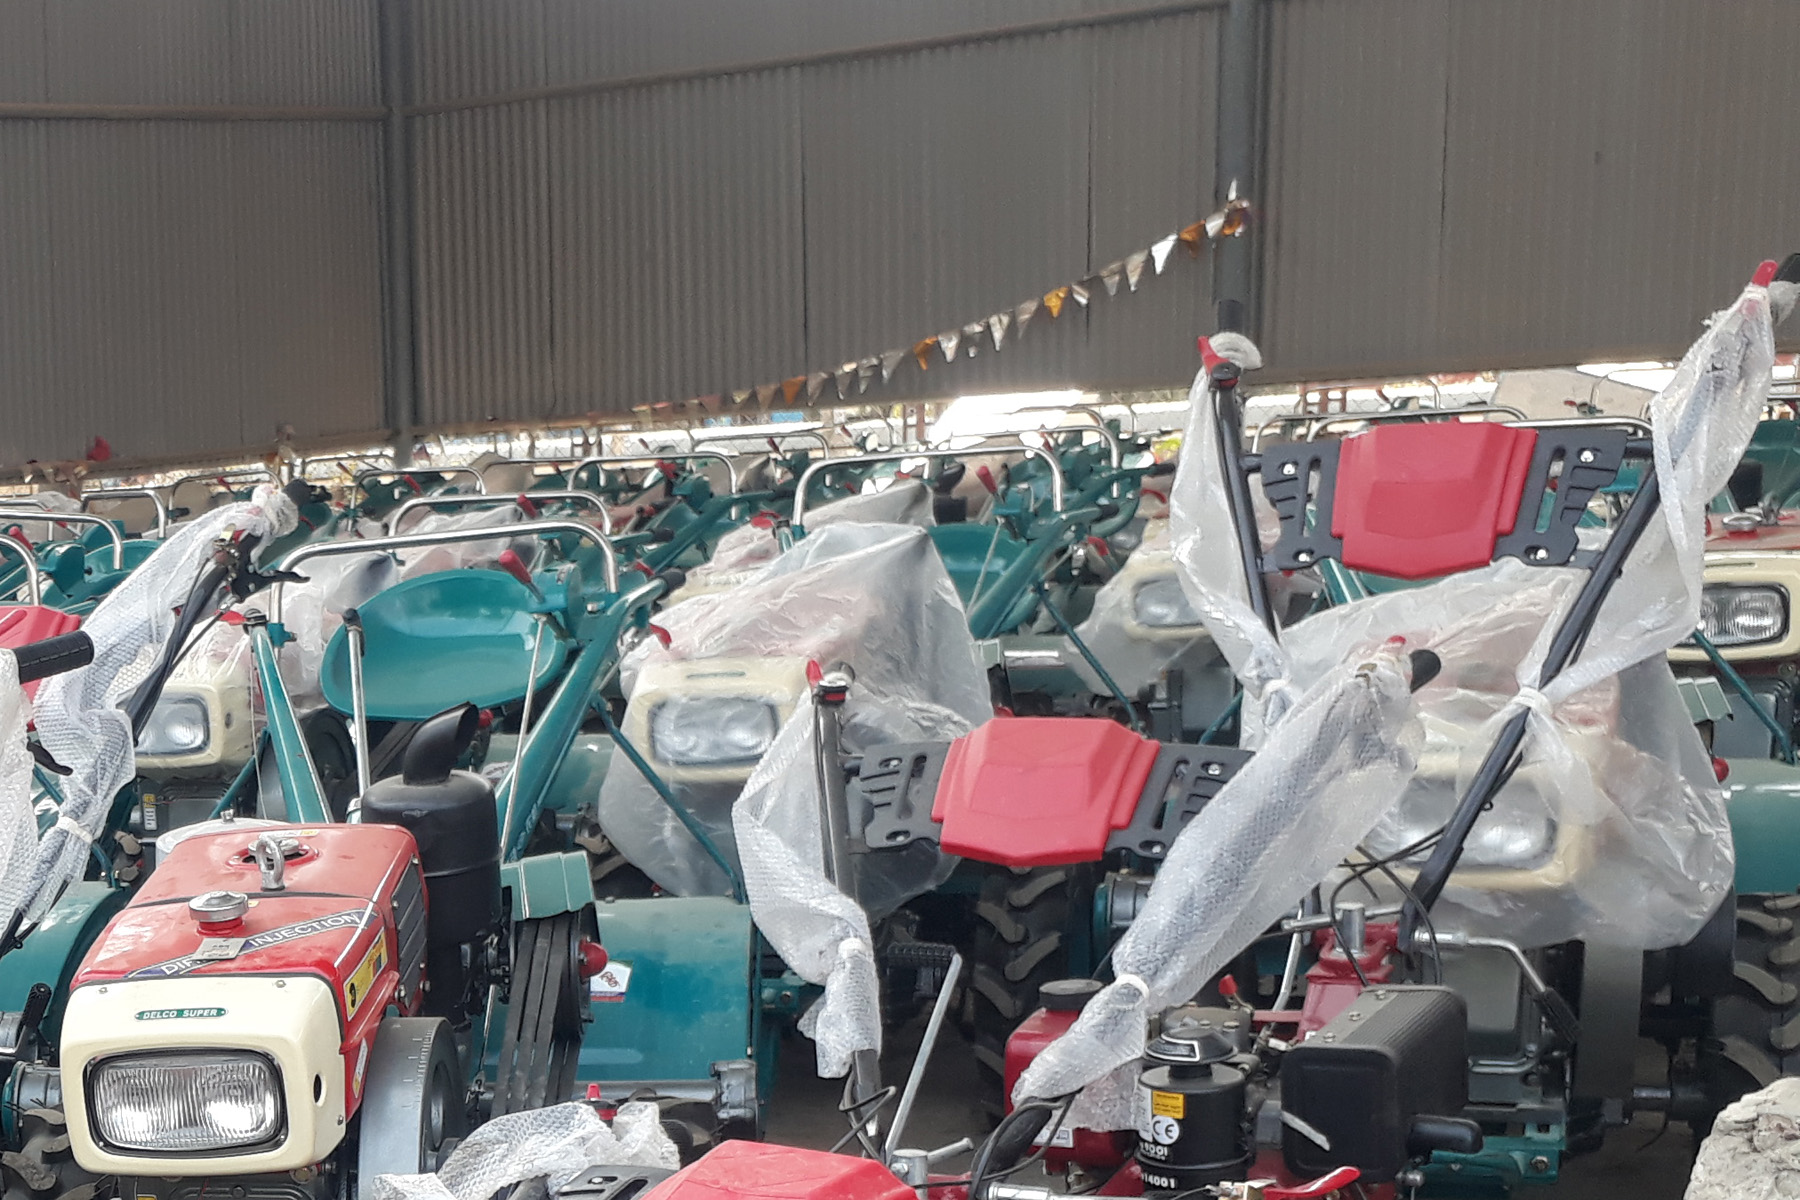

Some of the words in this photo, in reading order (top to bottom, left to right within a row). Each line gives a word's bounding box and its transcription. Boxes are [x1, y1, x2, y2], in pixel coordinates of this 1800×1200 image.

[249, 912, 359, 947] INJECTION
[143, 1010, 177, 1019] DELCO
[183, 1008, 217, 1018] SUPER
[1152, 1120, 1175, 1140] CE
